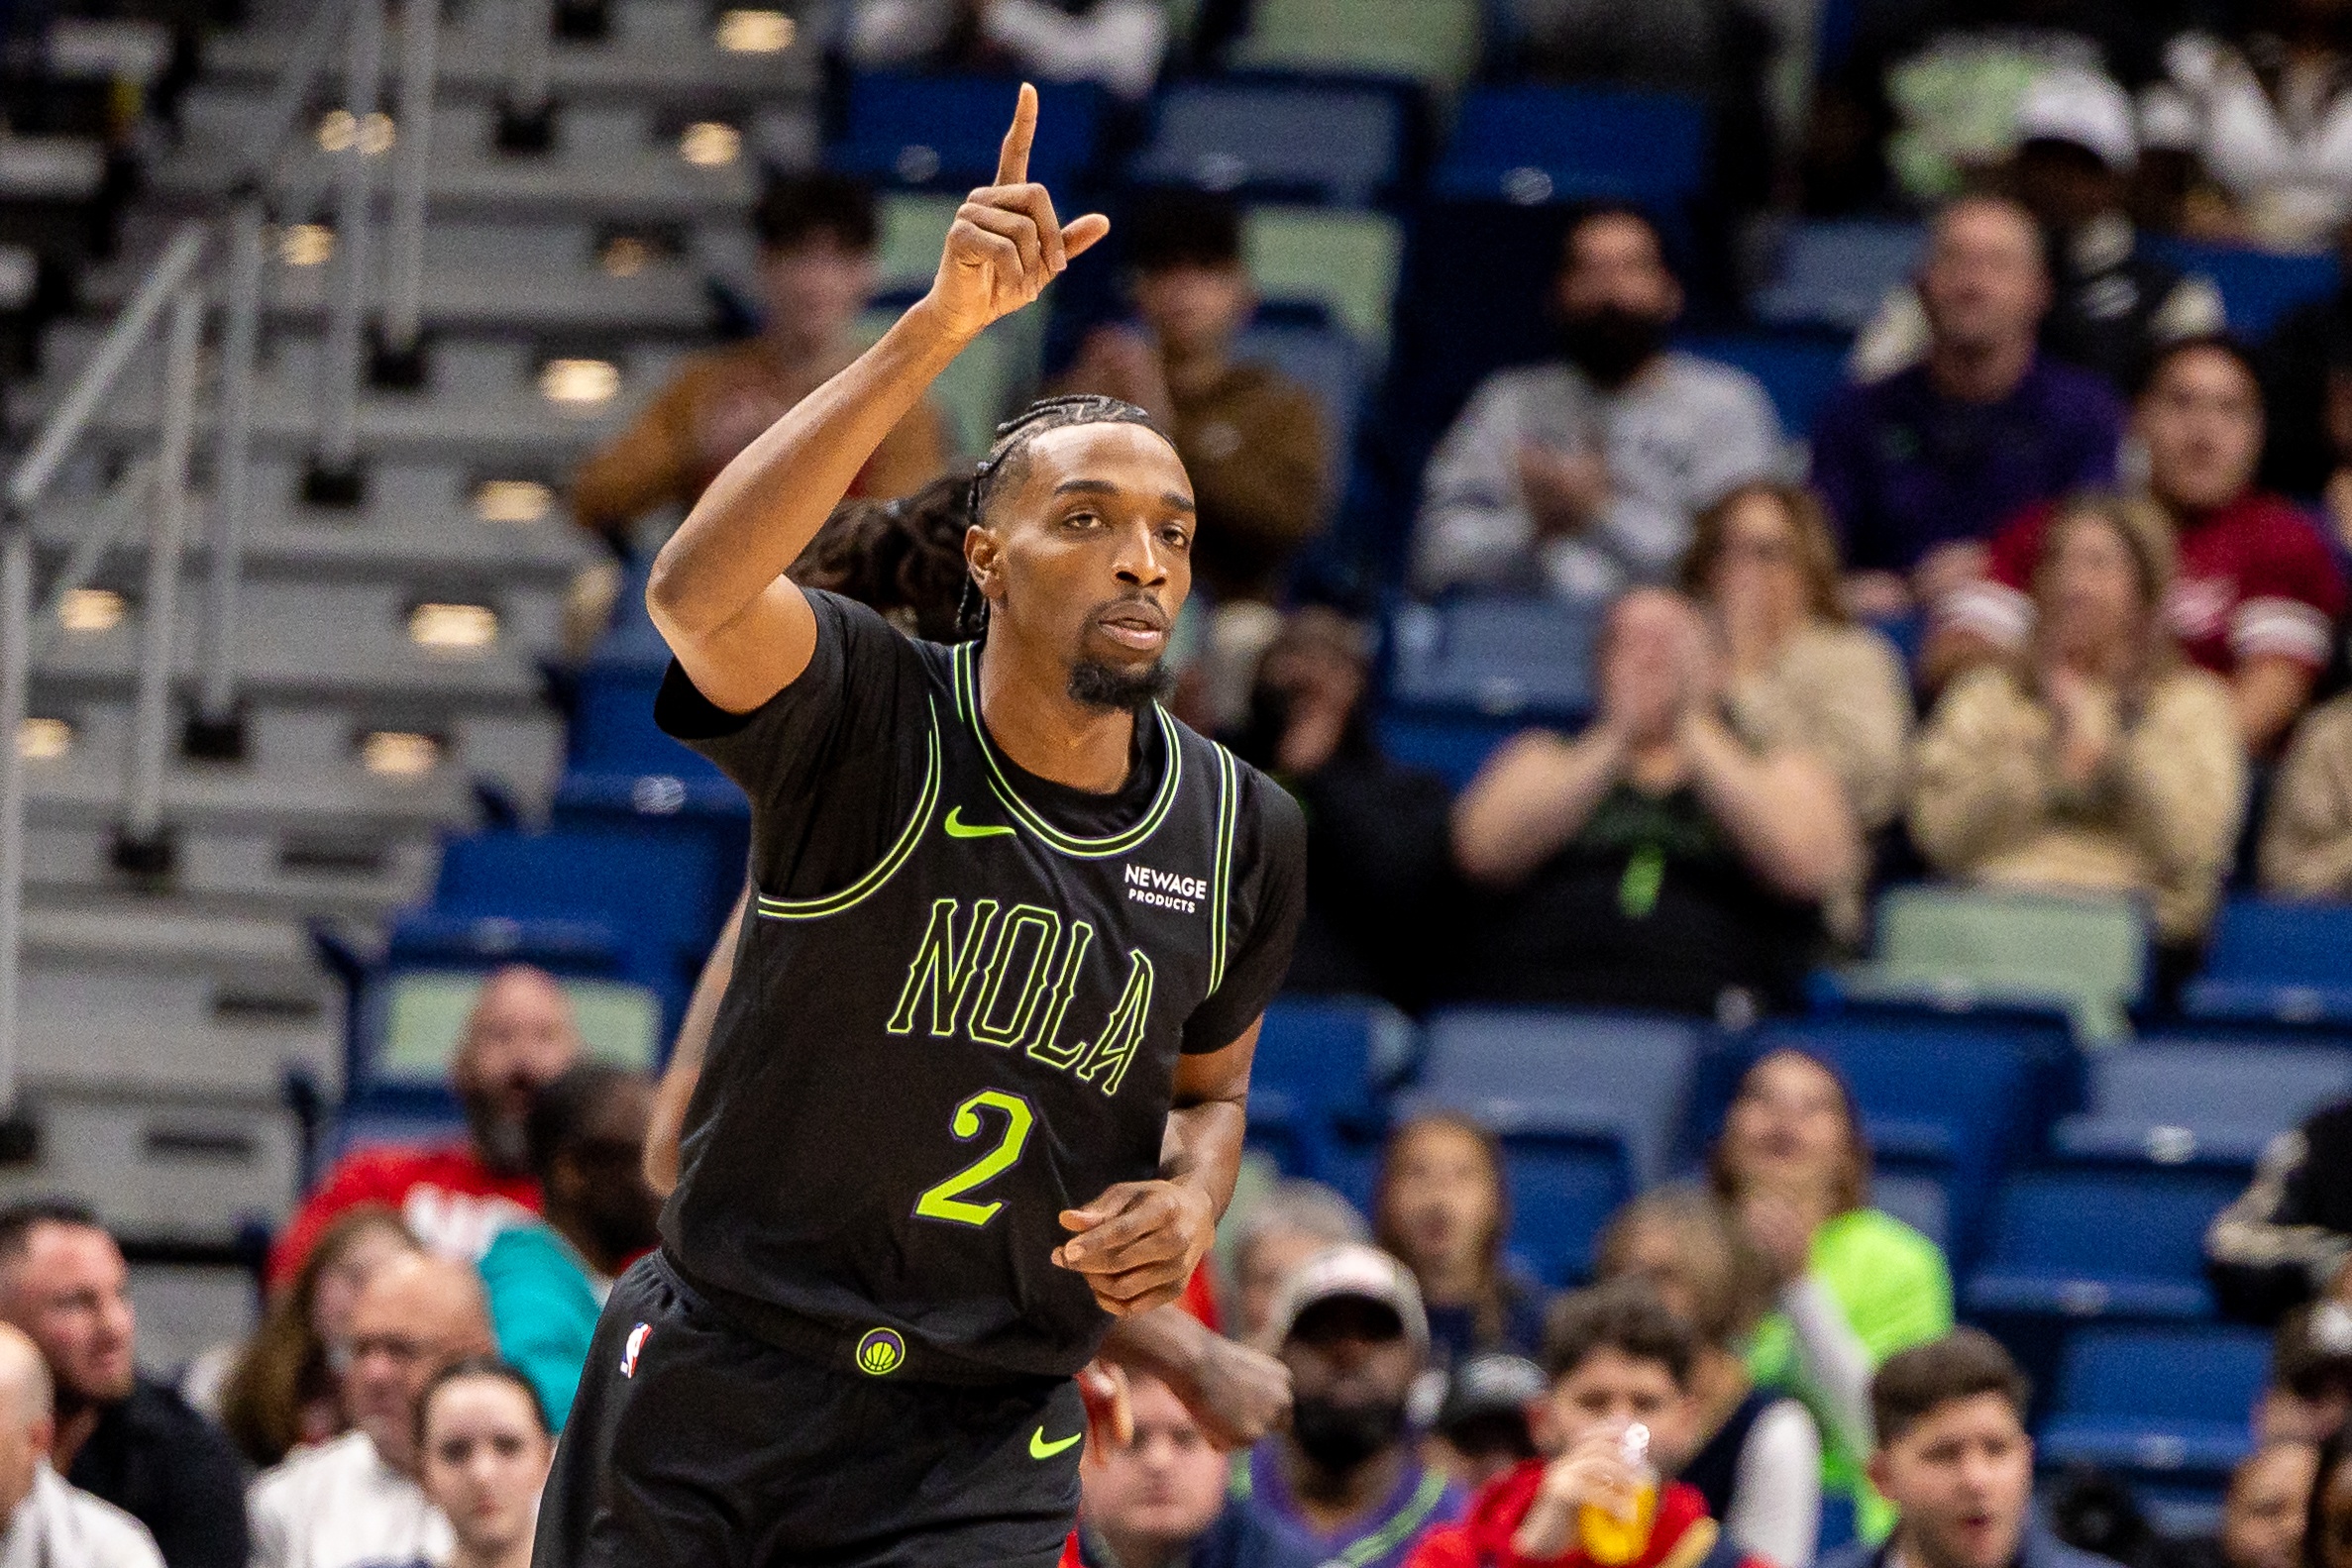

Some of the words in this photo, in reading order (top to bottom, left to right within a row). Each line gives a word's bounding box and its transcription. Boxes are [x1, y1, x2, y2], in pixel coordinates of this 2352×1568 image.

[1124, 863, 1207, 899] NEWAGE
[1128, 889, 1196, 913] PRODUCTS
[887, 898, 1154, 1096] NOLA
[912, 1089, 1035, 1227] 2
